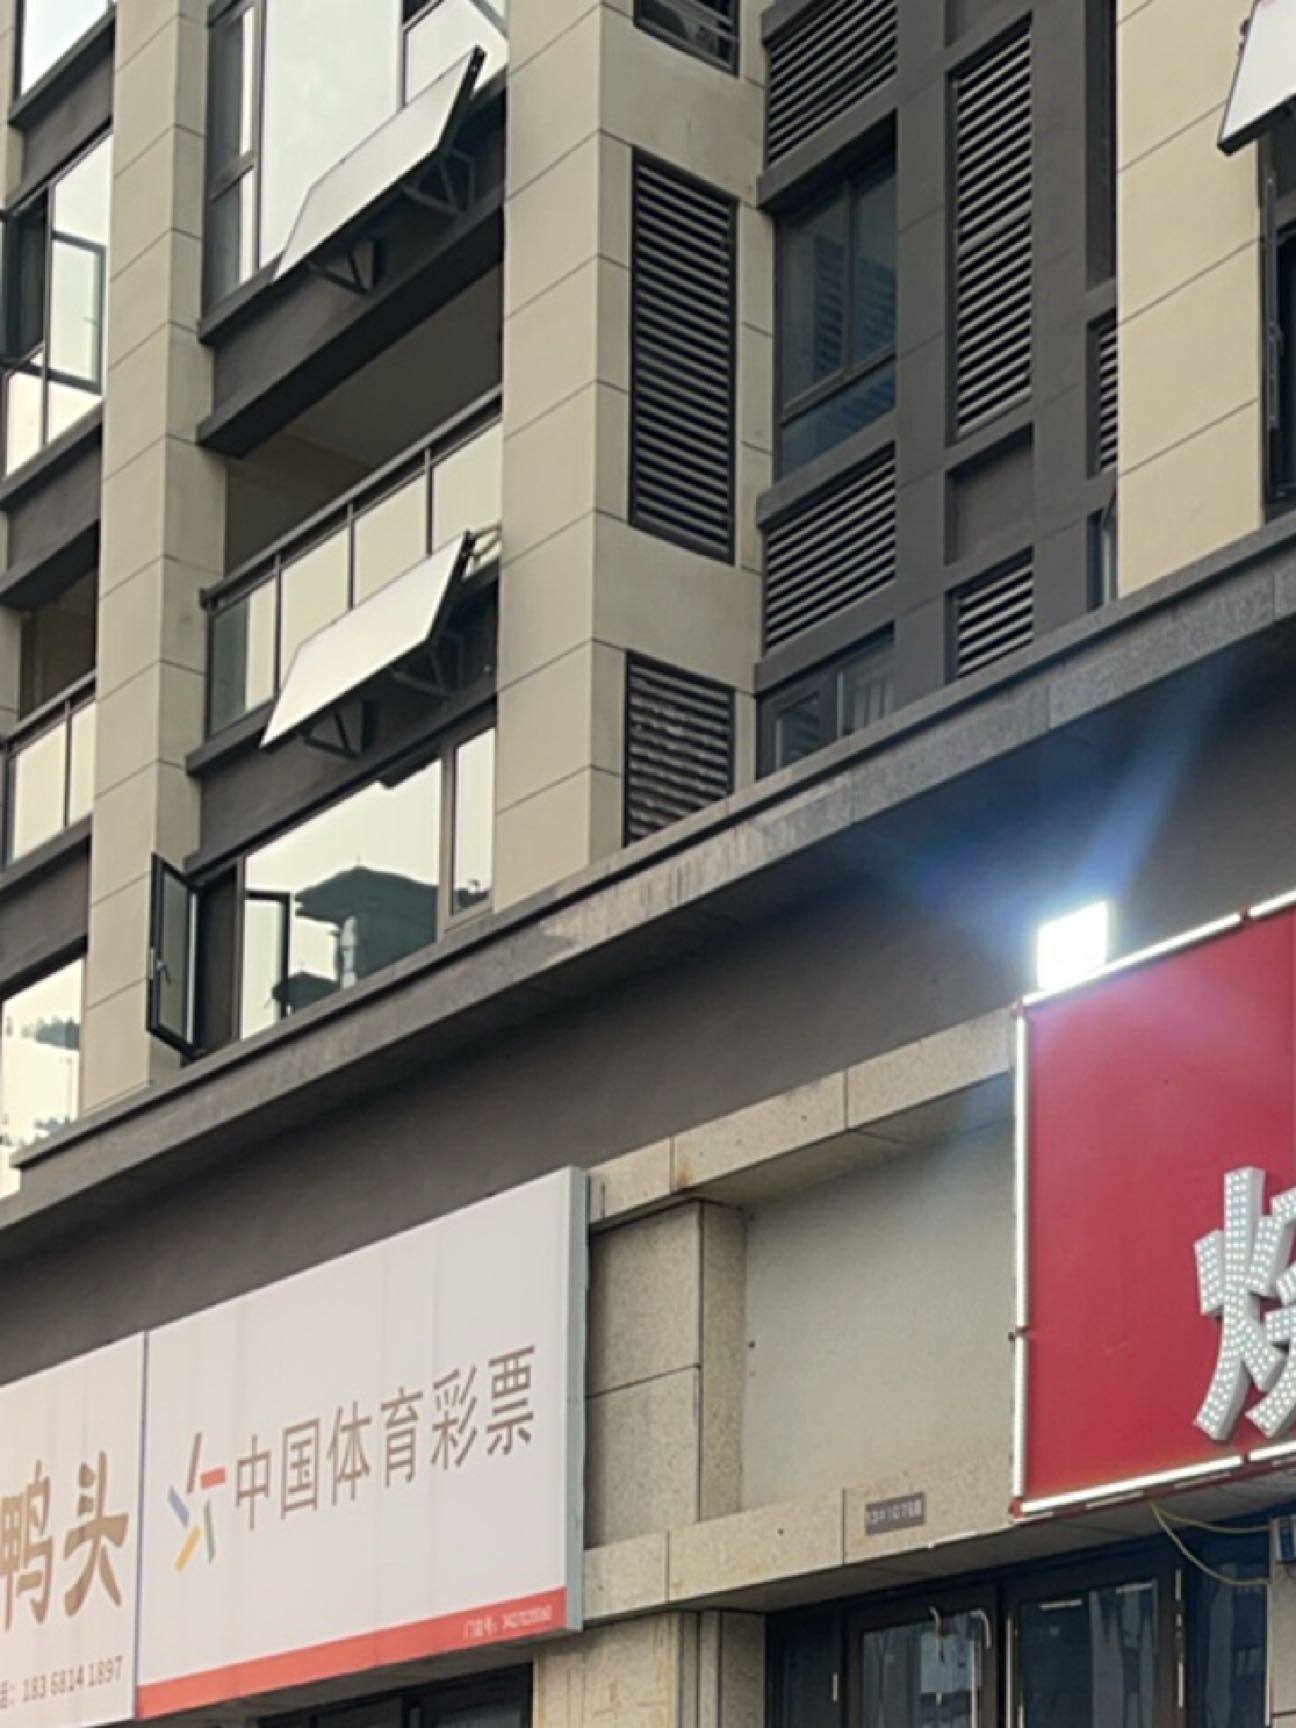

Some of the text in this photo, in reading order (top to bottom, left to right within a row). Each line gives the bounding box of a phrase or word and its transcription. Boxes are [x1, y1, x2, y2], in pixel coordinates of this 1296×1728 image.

[235, 1345, 535, 1531] 中国体育彩票
